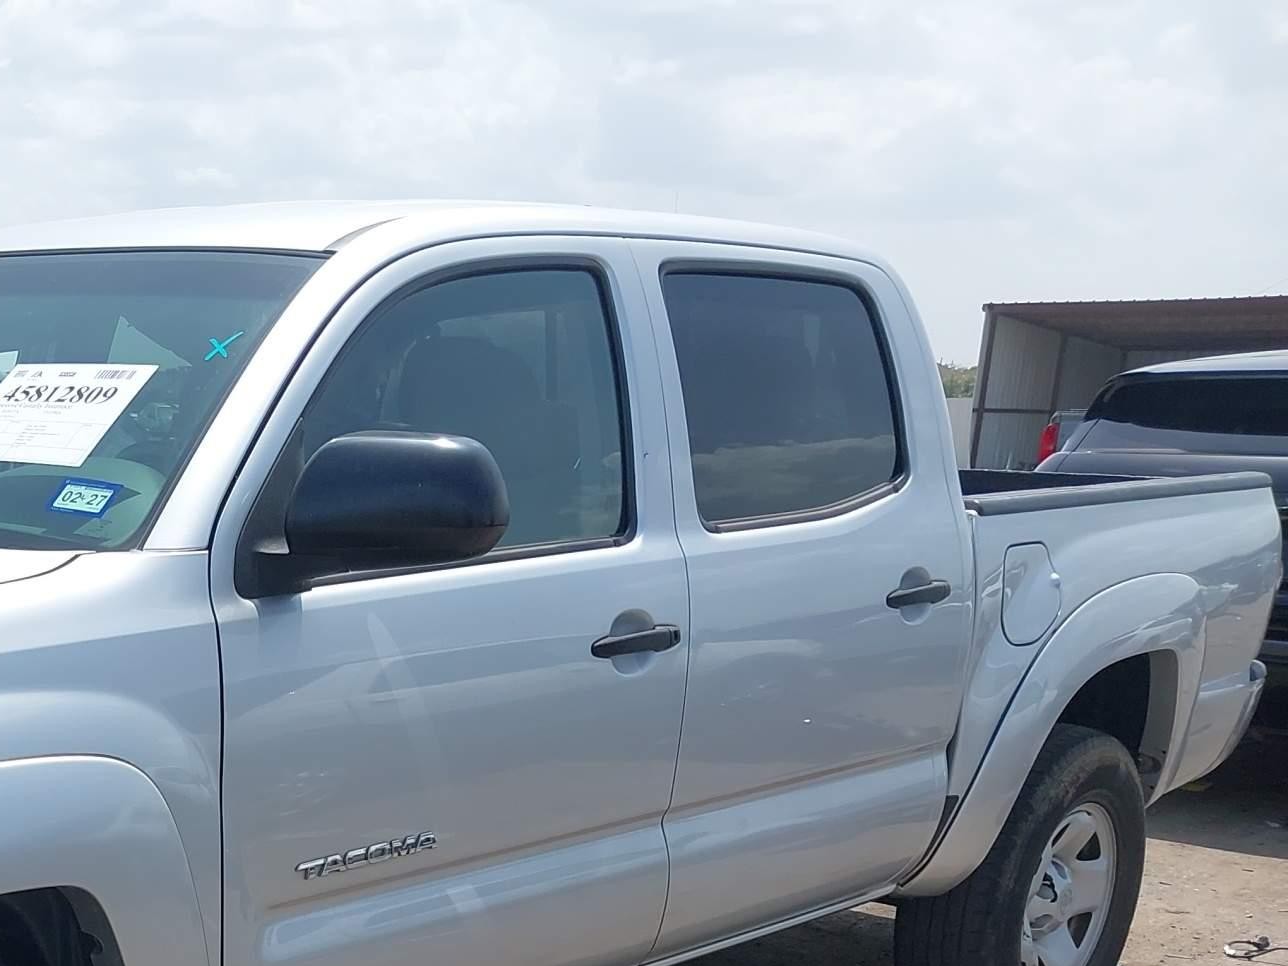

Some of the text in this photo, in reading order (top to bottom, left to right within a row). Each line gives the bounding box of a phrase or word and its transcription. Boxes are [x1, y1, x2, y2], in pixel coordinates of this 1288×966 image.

[3, 384, 119, 404] 45812809
[61, 490, 82, 504] 02
[86, 493, 109, 507] 27
[294, 830, 438, 880] TACOMA
